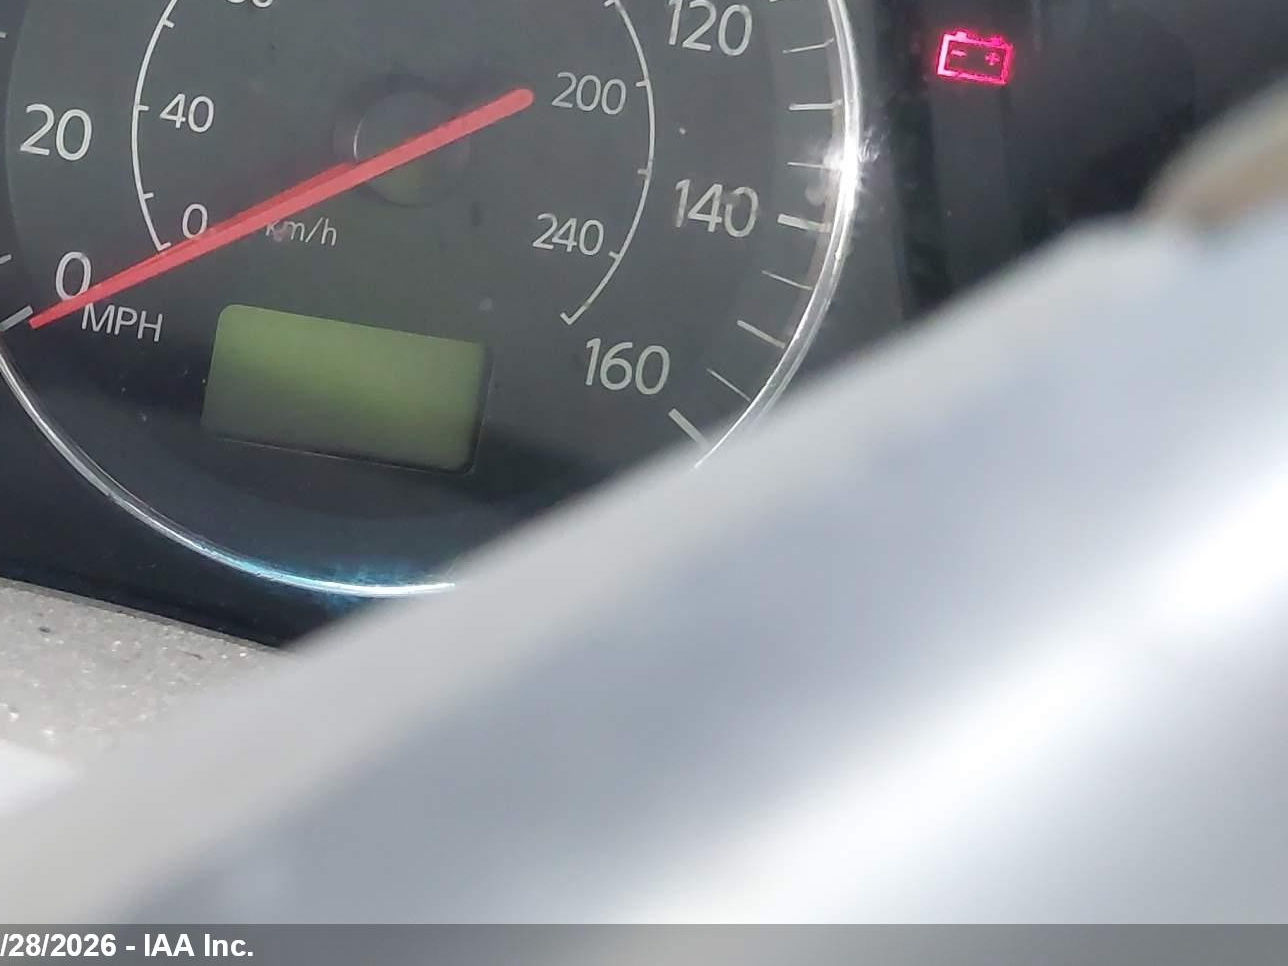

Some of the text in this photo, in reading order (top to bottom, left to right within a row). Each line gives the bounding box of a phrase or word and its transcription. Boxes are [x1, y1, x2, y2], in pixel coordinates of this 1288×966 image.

[159, 93, 215, 133] 40
[551, 72, 627, 116] 200
[19, 103, 93, 162] 20
[181, 203, 209, 240] 0
[673, 178, 759, 238] 140
[531, 212, 604, 256] 240
[54, 251, 93, 303] 0
[81, 303, 163, 343] MPH
[584, 337, 670, 395] 160
